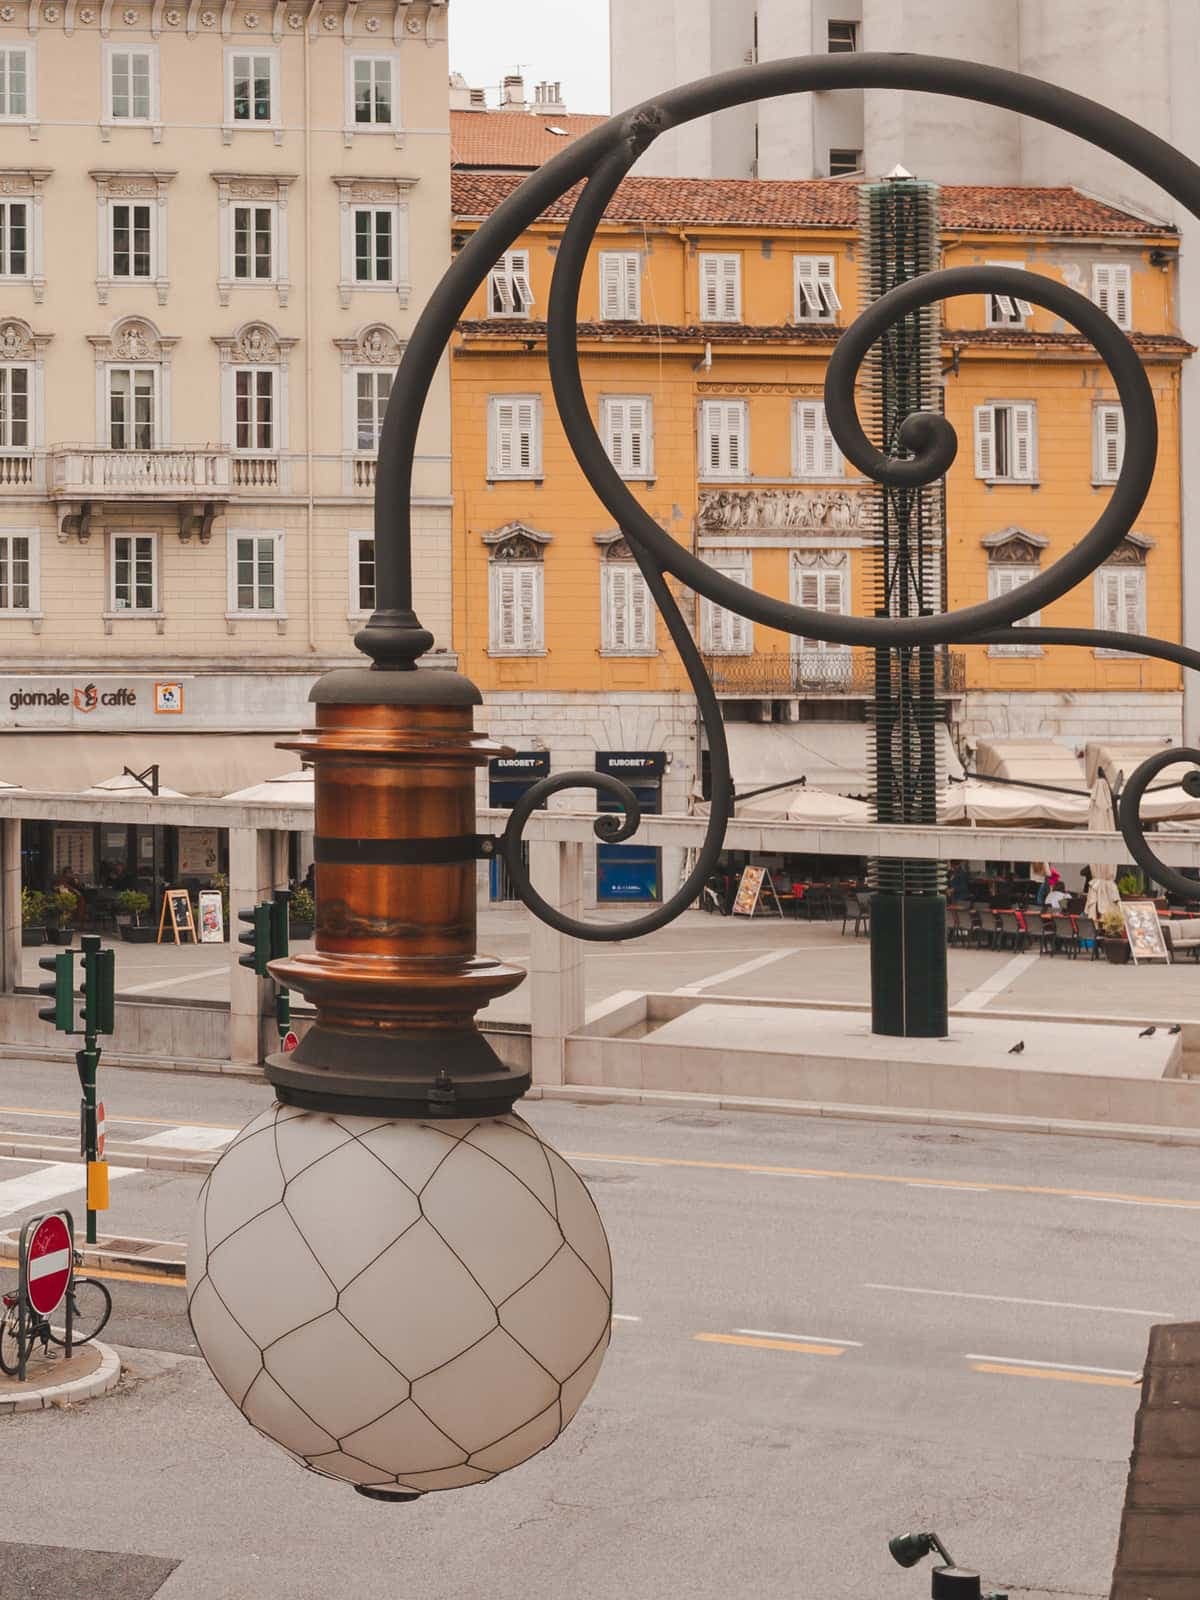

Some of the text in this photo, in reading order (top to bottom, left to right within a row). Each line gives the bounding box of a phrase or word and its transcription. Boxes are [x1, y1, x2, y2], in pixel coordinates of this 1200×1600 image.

[9, 688, 70, 710] giornale
[498, 759, 536, 767] EUROBET
[608, 759, 646, 767] EUROBET
